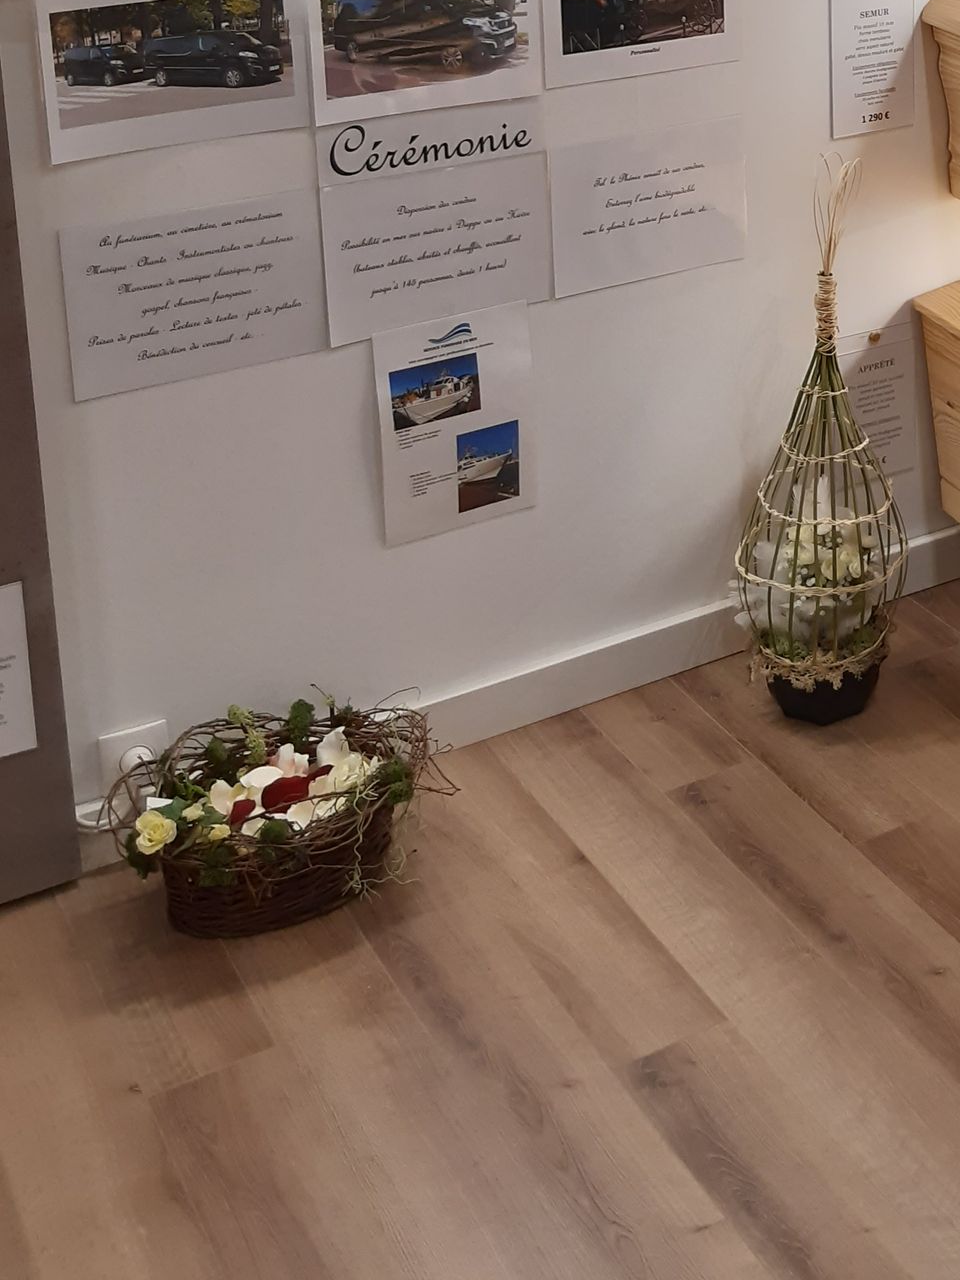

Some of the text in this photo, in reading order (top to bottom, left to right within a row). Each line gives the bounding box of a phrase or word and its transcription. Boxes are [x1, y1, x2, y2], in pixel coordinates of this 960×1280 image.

[859, 7, 890, 19] SEMUR
[862, 110, 891, 124] 1 290 €
[329, 122, 533, 177] Cérémonie
[396, 205, 436, 218] Dispersion
[98, 235, 112, 247] Au
[234, 212, 283, 225] crématorium
[340, 236, 381, 252] Possibilité
[455, 218, 481, 231] Dieppe
[85, 264, 127, 277] Musique
[136, 255, 167, 268] Chants
[175, 243, 241, 262] Instrumentistes
[256, 236, 294, 248] chanteurs
[117, 282, 163, 295] Morceaux
[165, 277, 175, 286] de
[178, 273, 212, 284] musique
[402, 278, 417, 289] 145
[173, 297, 210, 309] chansons
[210, 290, 252, 305] françaises
[117, 333, 127, 343] de
[126, 325, 160, 345] paroles
[168, 319, 200, 333] Lecture
[203, 316, 213, 326] de
[215, 312, 239, 324] textes
[272, 298, 302, 317] pétales
[136, 333, 235, 362] Bénédiction du cercueil
